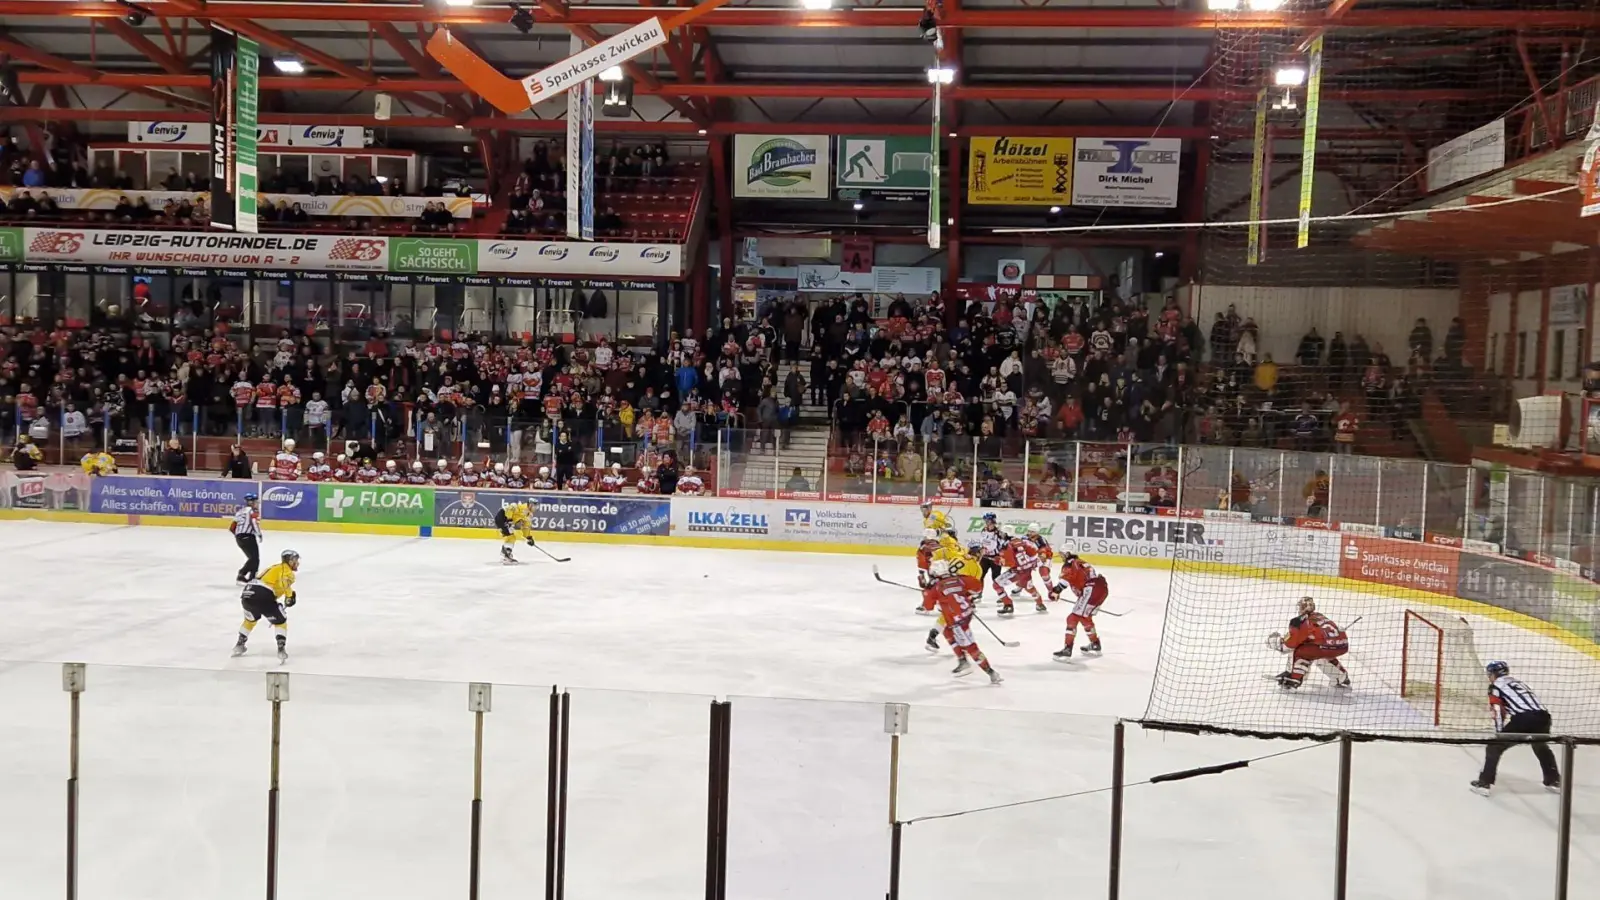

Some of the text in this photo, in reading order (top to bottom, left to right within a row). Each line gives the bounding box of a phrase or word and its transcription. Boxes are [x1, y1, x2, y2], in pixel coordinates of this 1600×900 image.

[545, 53, 607, 87] Sparkasse
[608, 28, 658, 57] Zwickau
[215, 124, 225, 179] EMH
[993, 137, 1048, 156] Hölzel
[749, 152, 814, 180] Bad Brambacher
[1099, 175, 1118, 183] Dirk
[302, 201, 328, 210] milch
[93, 233, 318, 250] LEIPZIG-AUTOHANDEL.DE
[109, 252, 131, 260] IHR
[136, 252, 228, 263] WUNSCHAUTO
[418, 247, 458, 257] SO GEHT
[400, 254, 466, 269] SÄCHSISCH.
[589, 280, 614, 288] freenet
[101, 485, 236, 500] Alles wollen. Alles können.
[360, 491, 423, 509] FLORA
[101, 499, 245, 513] Alles schaffen. MIT ENERG
[440, 517, 495, 526] MEERANE
[816, 510, 856, 519] Volksbank
[628, 520, 638, 530] 10
[815, 520, 854, 529] Chemnitz
[1065, 516, 1205, 545] HERCHER
[1433, 536, 1455, 544] CCM
[1097, 540, 1158, 557] Service
[1165, 544, 1224, 562] Familie
[1363, 551, 1411, 567] Sparkasse
[1413, 559, 1449, 574] Zwickau
[1361, 565, 1378, 577] Gut
[1381, 567, 1395, 579] für
[1397, 570, 1411, 580] die
